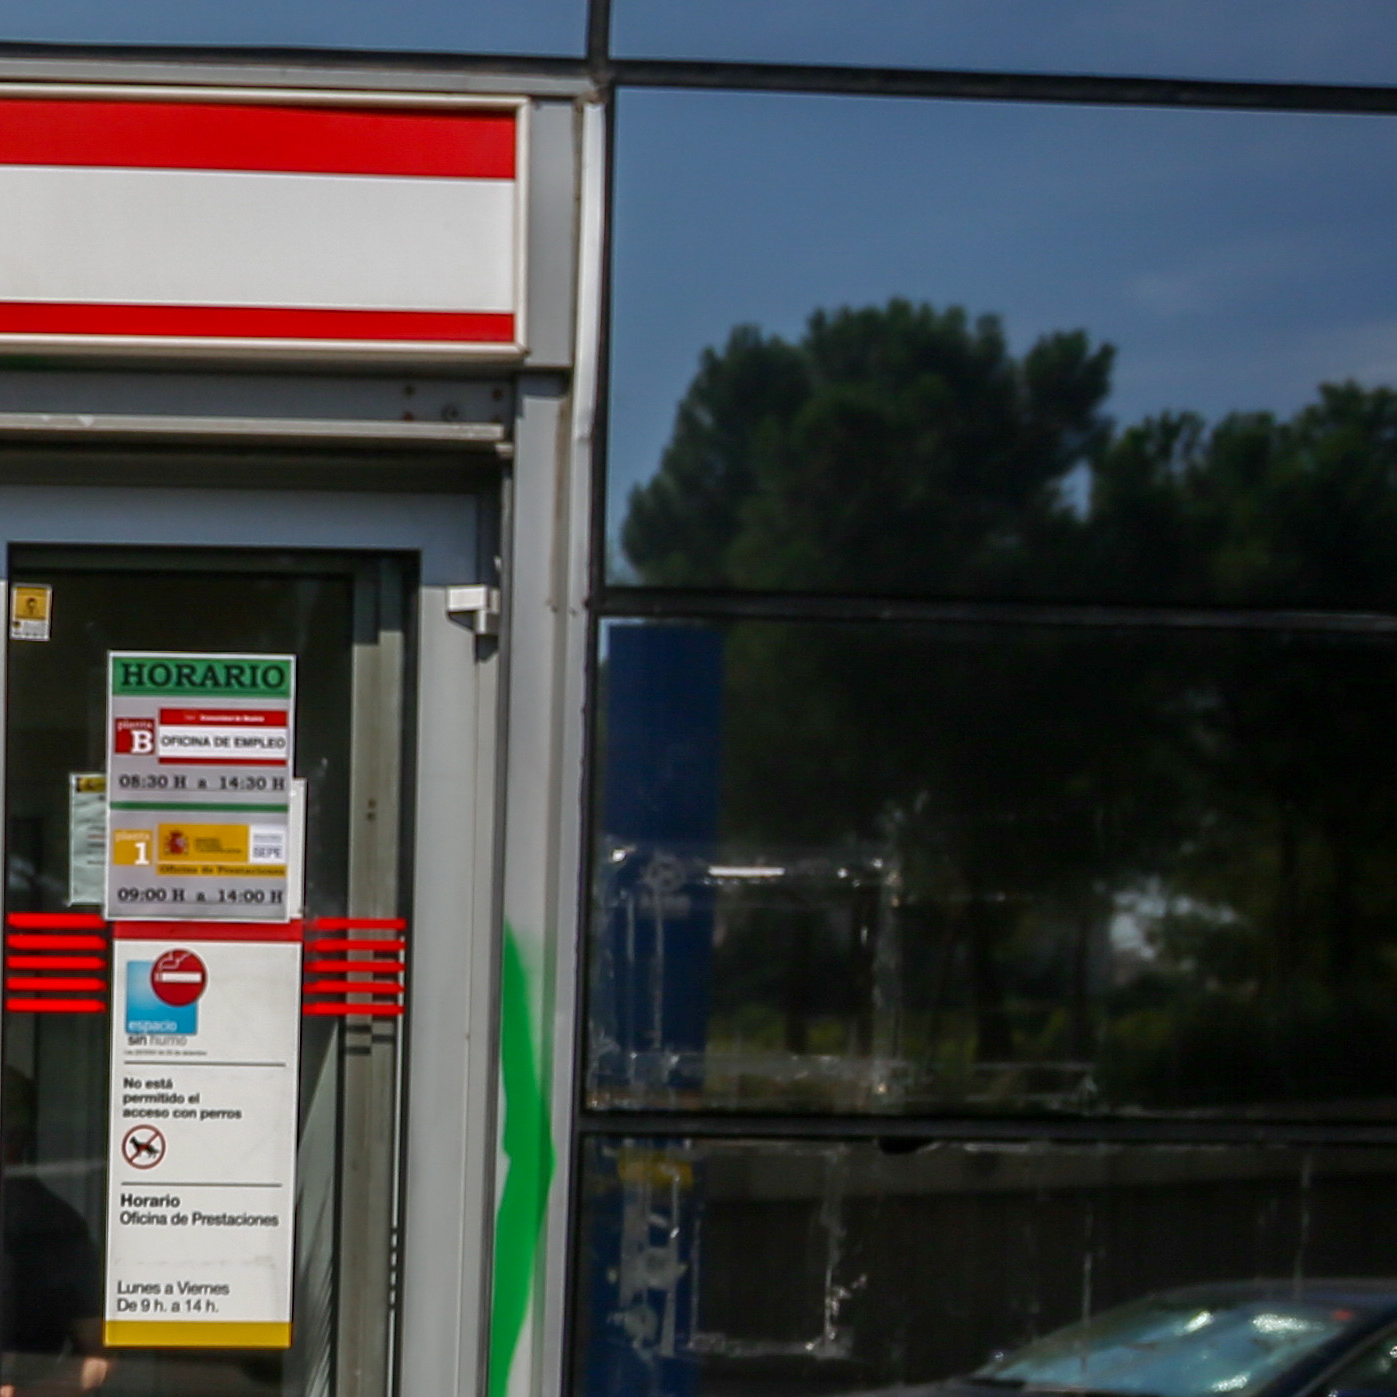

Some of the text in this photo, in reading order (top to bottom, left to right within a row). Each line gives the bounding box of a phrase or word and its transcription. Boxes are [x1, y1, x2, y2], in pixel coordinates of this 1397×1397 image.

[121, 663, 285, 689] HORARIO
[131, 730, 154, 754] B
[160, 735, 286, 749] OFICINA DE EMPLEO
[119, 775, 285, 791] 08:30 H a 14:30 H
[134, 841, 151, 866] 1
[118, 888, 283, 904] 09:00 H a 14:00 H
[128, 1020, 178, 1034] espacio
[128, 1033, 147, 1046] sin
[123, 1077, 173, 1090] No está
[123, 1093, 200, 1106] permitido el
[123, 1108, 243, 1121] acceso con perros
[120, 1193, 181, 1208] Horario
[120, 1210, 279, 1227] Oficina de Prestaciones
[117, 1280, 230, 1296] Lunes a Viernes
[117, 1298, 219, 1313] De 9 h. a 14 h.
